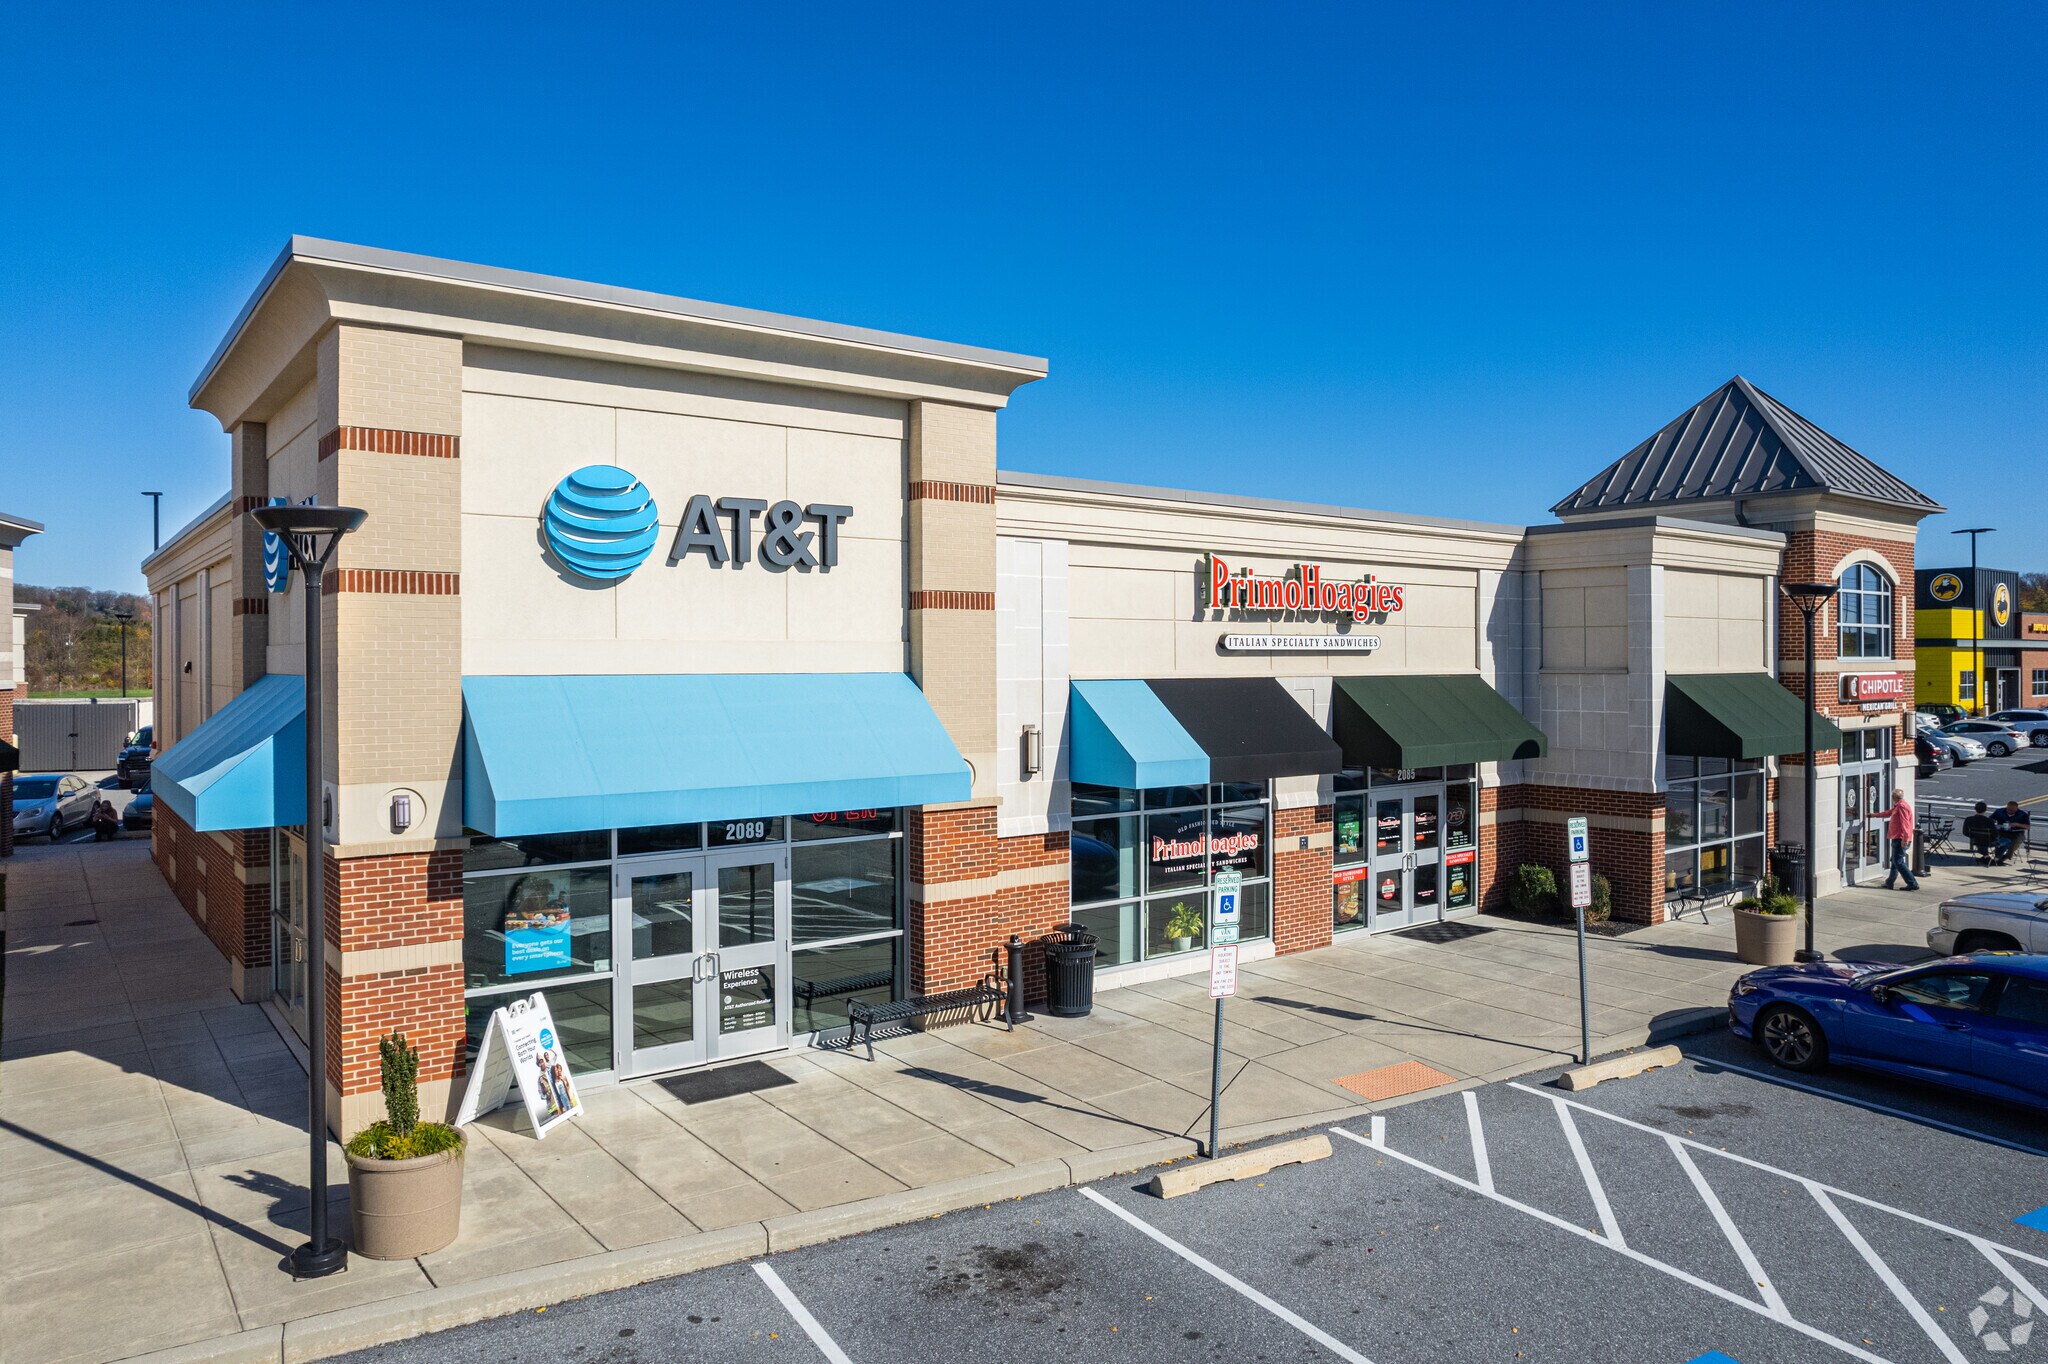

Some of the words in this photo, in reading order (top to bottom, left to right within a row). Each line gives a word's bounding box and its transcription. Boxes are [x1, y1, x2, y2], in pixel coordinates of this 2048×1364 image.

[671, 494, 853, 566] AT&T
[1207, 553, 1404, 622] PrimoHoagies
[1228, 637, 1268, 647] ITALIAN
[1271, 637, 1320, 648] SPECIALTY
[1323, 638, 1379, 648] SANDWICHES
[1861, 679, 1903, 694] CHIPOTLE
[1862, 703, 1884, 712] MEXICAN
[1884, 702, 1898, 710] GRILL
[1397, 769, 1416, 781] 2085
[725, 821, 764, 841] 2089
[1177, 825, 1188, 834] OLD
[1188, 819, 1219, 829] FASHIOED
[1165, 864, 1186, 873] ITALIAN
[1186, 861, 1215, 871] SPECIALY
[1216, 857, 1248, 866] SANDWICHES
[723, 969, 760, 980] Wireless
[723, 979, 758, 989] Experience
[735, 1000, 756, 1009] Authorized
[515, 1038, 537, 1051] Connecting
[517, 1049, 528, 1057] Both
[519, 1054, 534, 1064] Worlds
